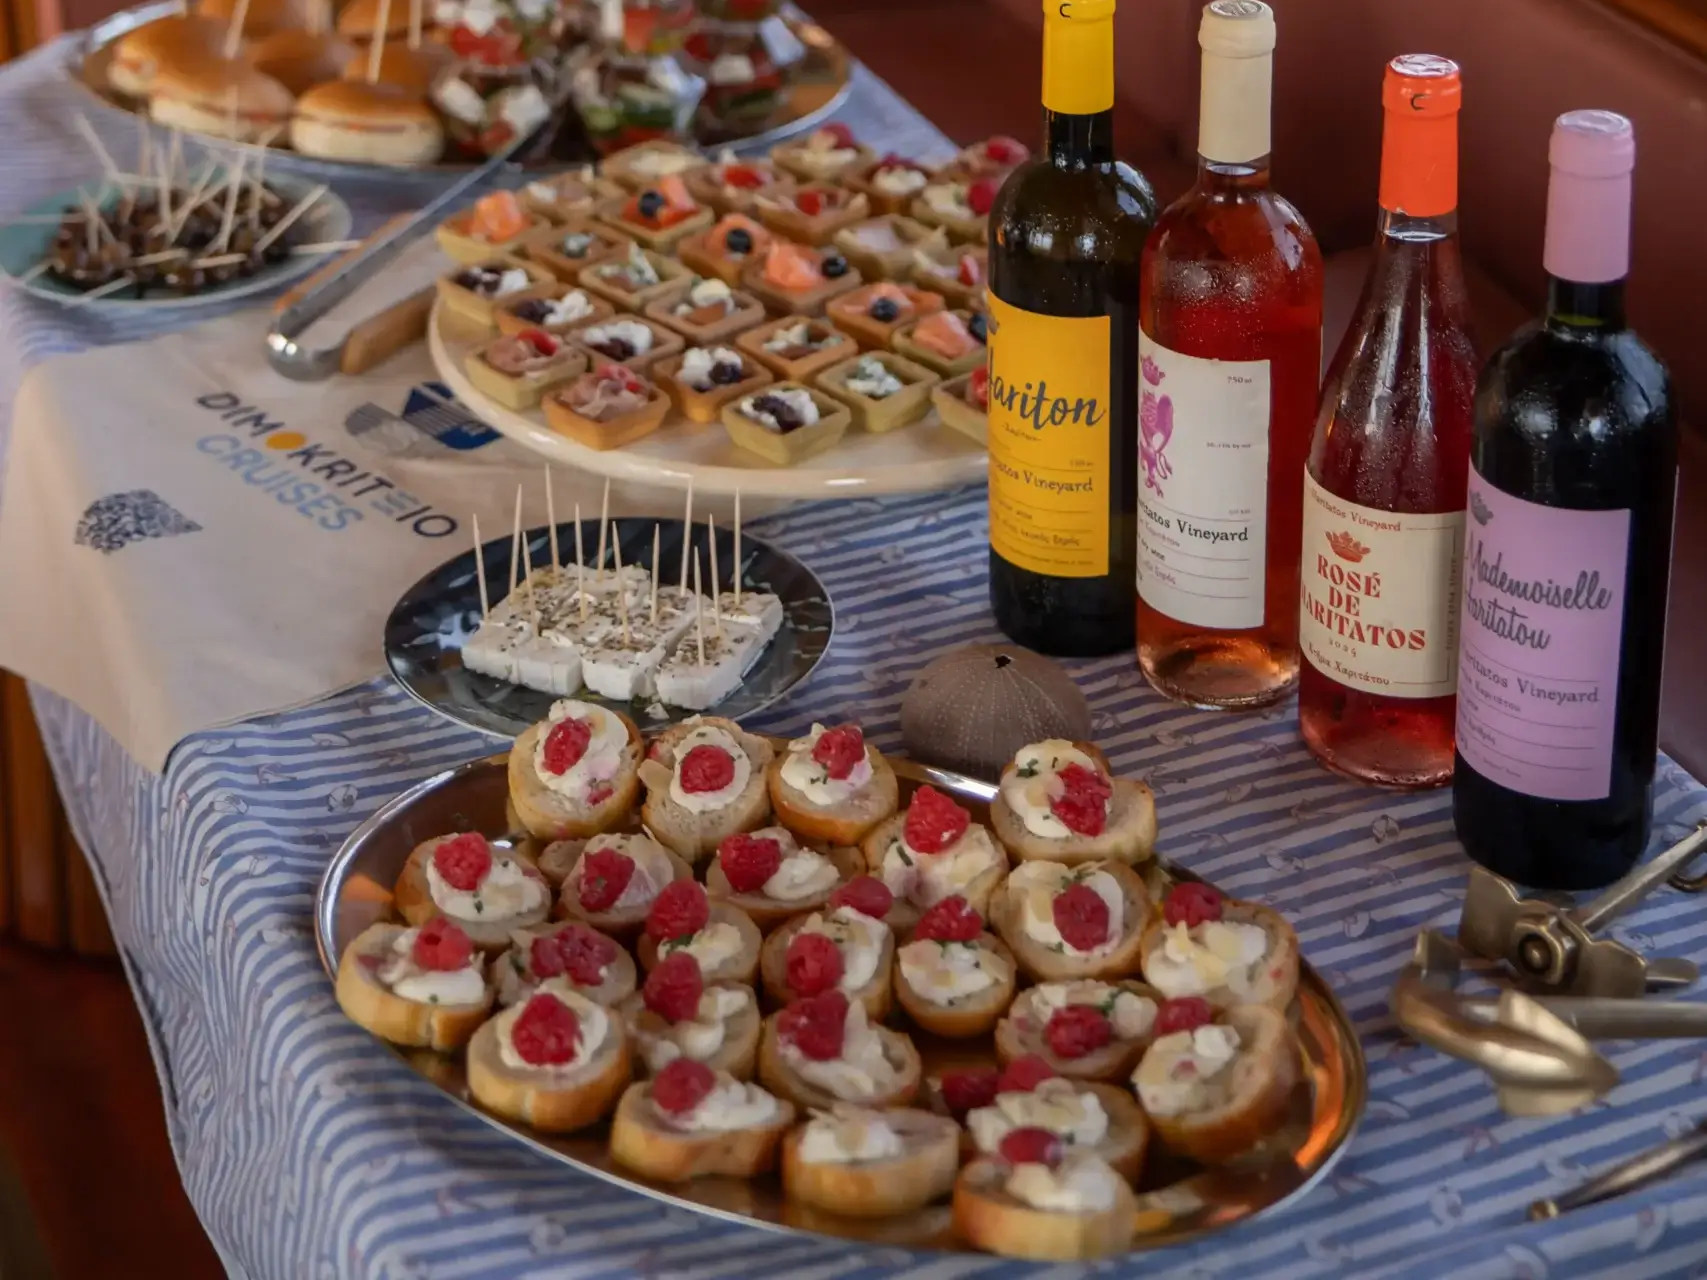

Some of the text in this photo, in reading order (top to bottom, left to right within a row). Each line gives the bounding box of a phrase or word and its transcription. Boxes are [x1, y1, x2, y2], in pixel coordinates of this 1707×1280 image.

[196, 434, 364, 531] CRUISES
[1023, 469, 1094, 495] Vineyard
[1176, 518, 1249, 544] Vineyard
[1351, 513, 1401, 531] Vineyard
[1317, 553, 1382, 599] ROSÉ
[1468, 530, 1613, 610] Mademoiselle
[1328, 584, 1360, 617] DE
[1335, 660, 1391, 687] Χαριτάτου
[1516, 677, 1600, 707] Vineyard
